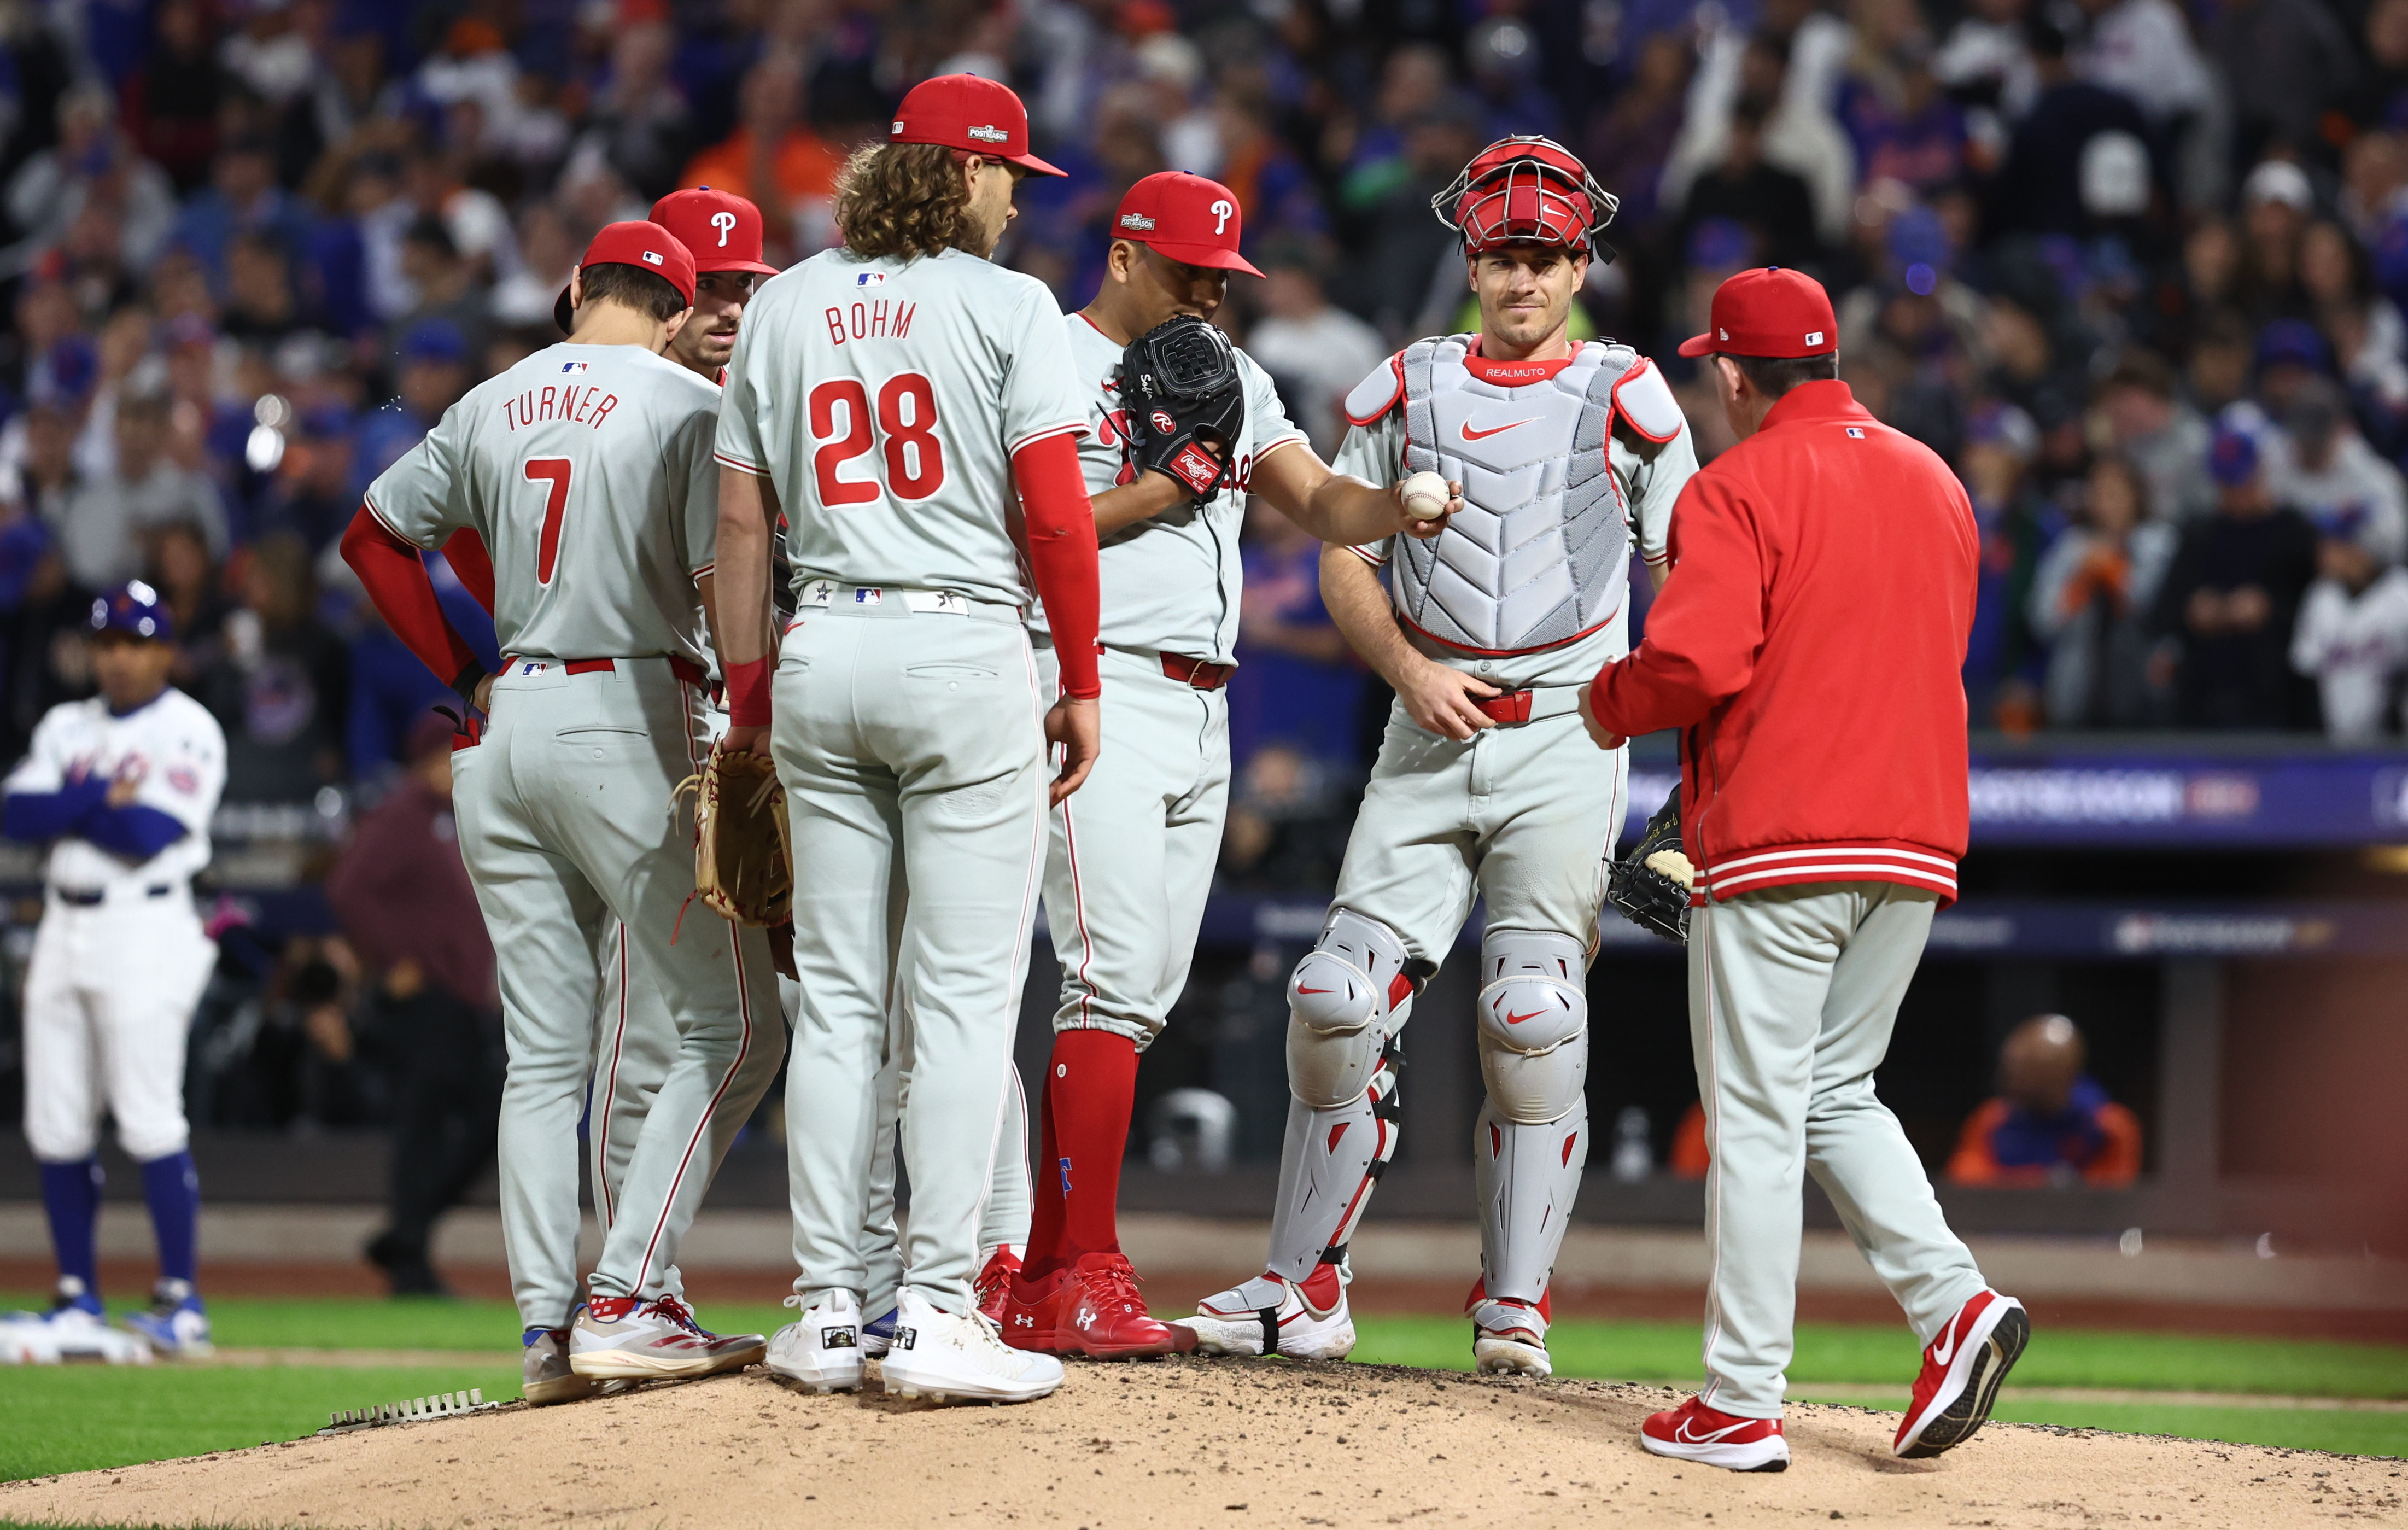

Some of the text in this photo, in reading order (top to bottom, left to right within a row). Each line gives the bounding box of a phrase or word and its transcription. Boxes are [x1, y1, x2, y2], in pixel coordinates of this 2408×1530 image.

[969, 129, 1007, 140] POSTSEASON
[710, 212, 737, 248] P
[1121, 218, 1153, 229] POSTSEASON
[1210, 200, 1233, 235] P
[825, 299, 917, 347] BOHM
[1486, 368, 1545, 377] REALMUTO
[502, 383, 619, 433] TURNER
[1152, 413, 1172, 432] R
[806, 369, 949, 510] 28
[1180, 454, 1213, 480] Rawlings
[522, 455, 574, 587] 7
[578, 1316, 585, 1326] 7
